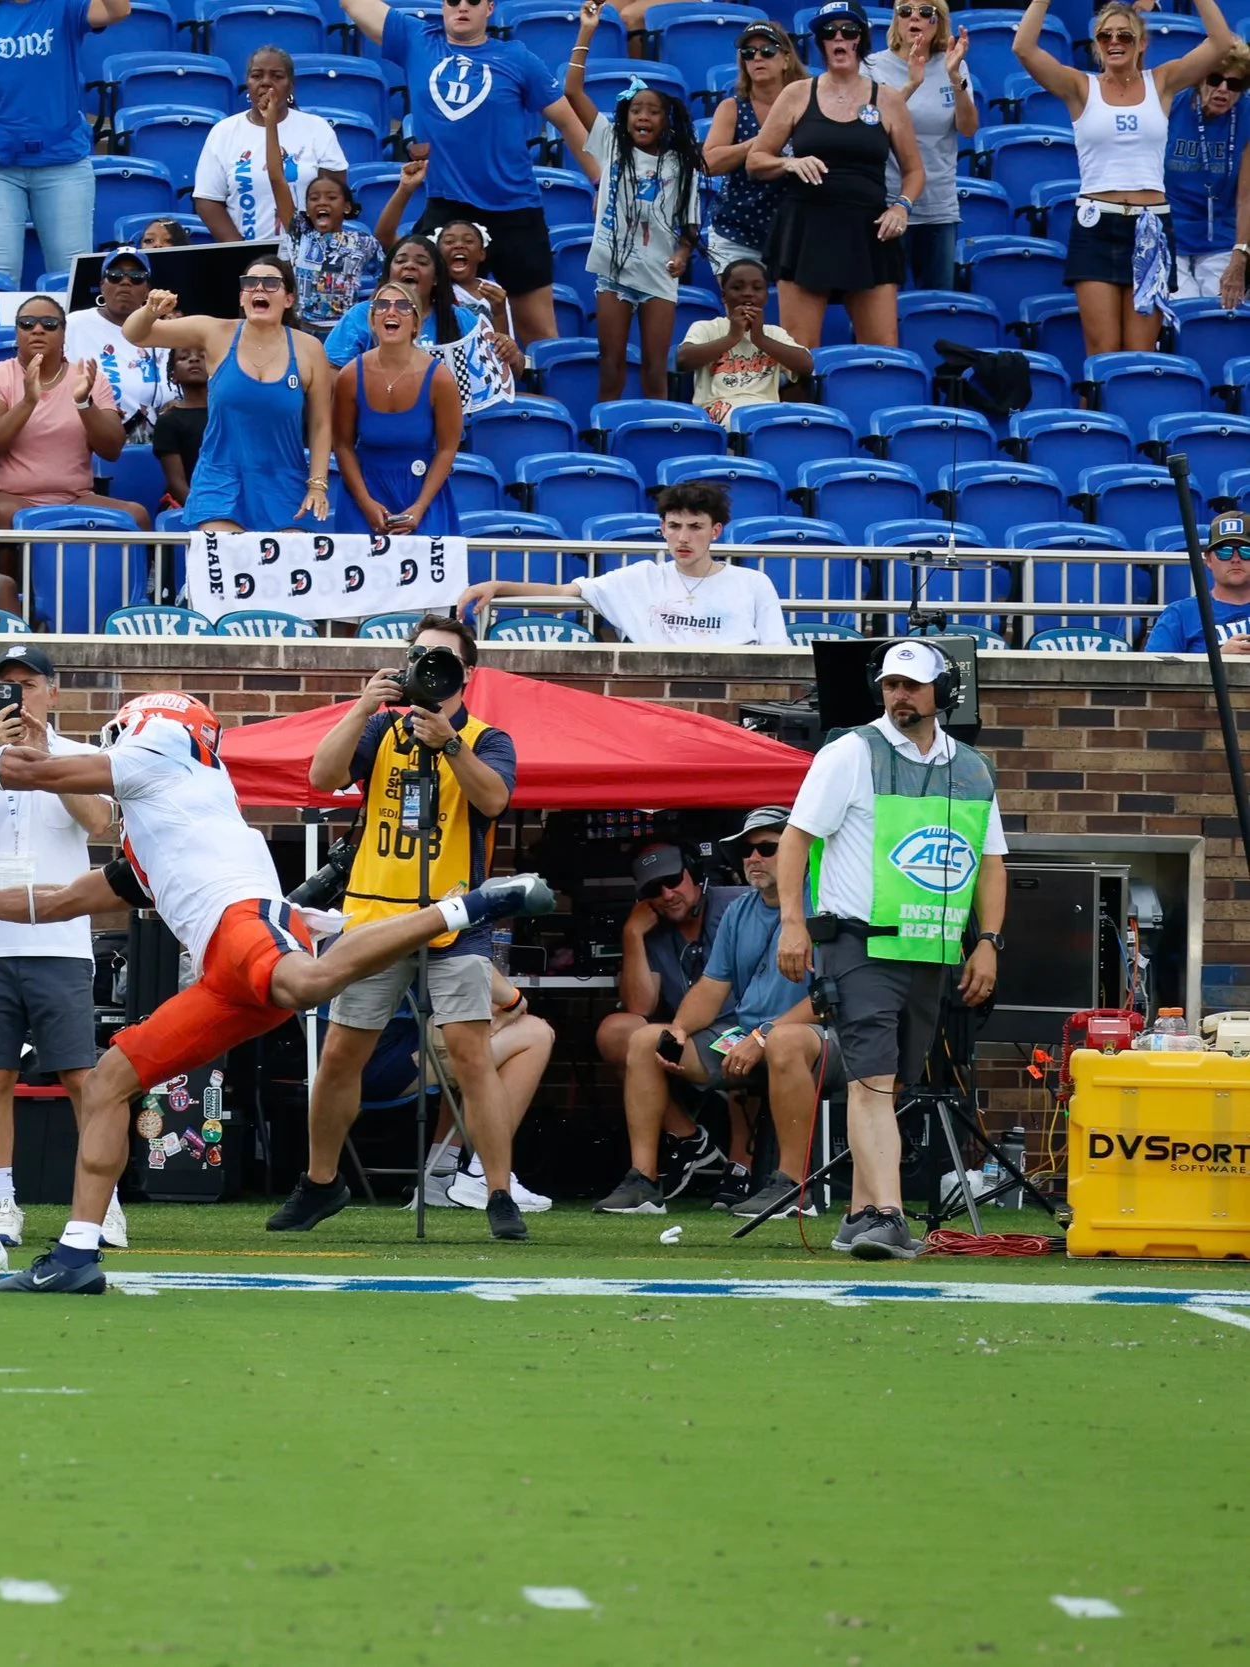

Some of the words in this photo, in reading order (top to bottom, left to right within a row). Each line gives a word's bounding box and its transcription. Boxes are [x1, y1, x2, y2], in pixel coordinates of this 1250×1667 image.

[1116, 114, 1138, 131] 53
[638, 182, 651, 195] 7
[908, 843, 969, 868] ACC
[1170, 1163, 1247, 1174] SOFTWARE
